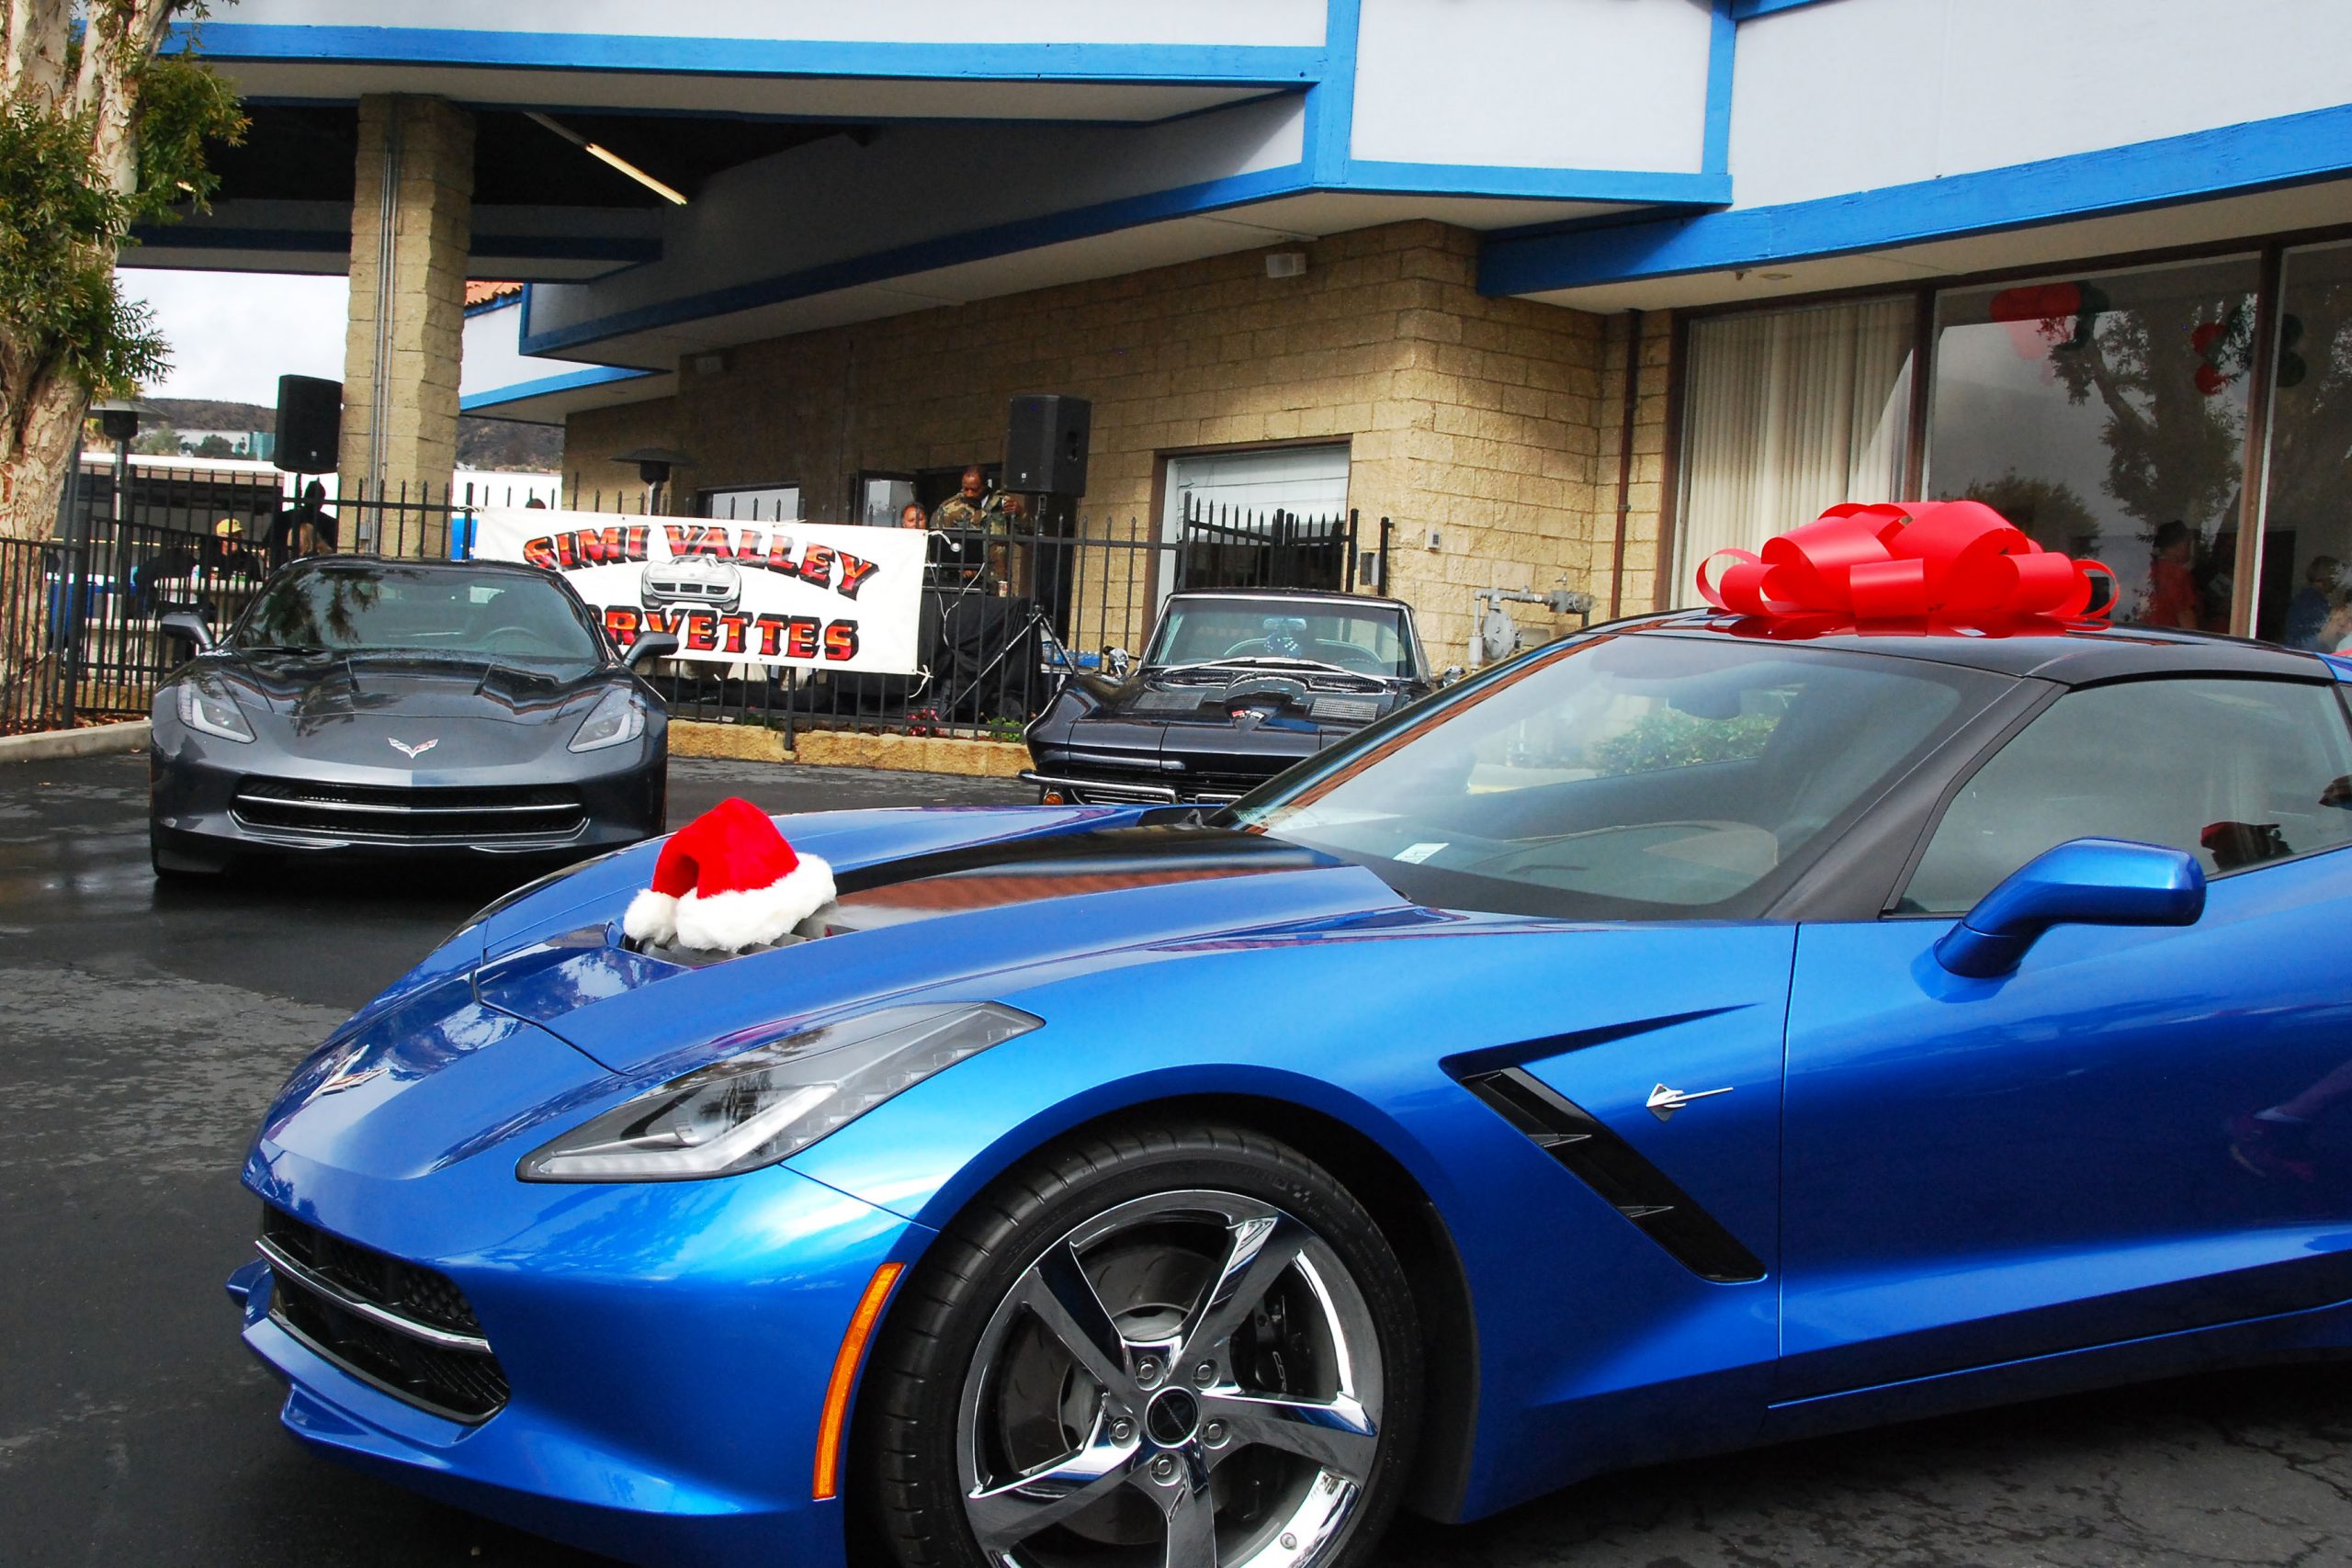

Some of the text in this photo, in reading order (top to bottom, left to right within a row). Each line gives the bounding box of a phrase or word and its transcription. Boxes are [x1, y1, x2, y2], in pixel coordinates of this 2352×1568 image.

[523, 525, 879, 601] SIMI VALLEY
[588, 604, 858, 661] RVETTES
